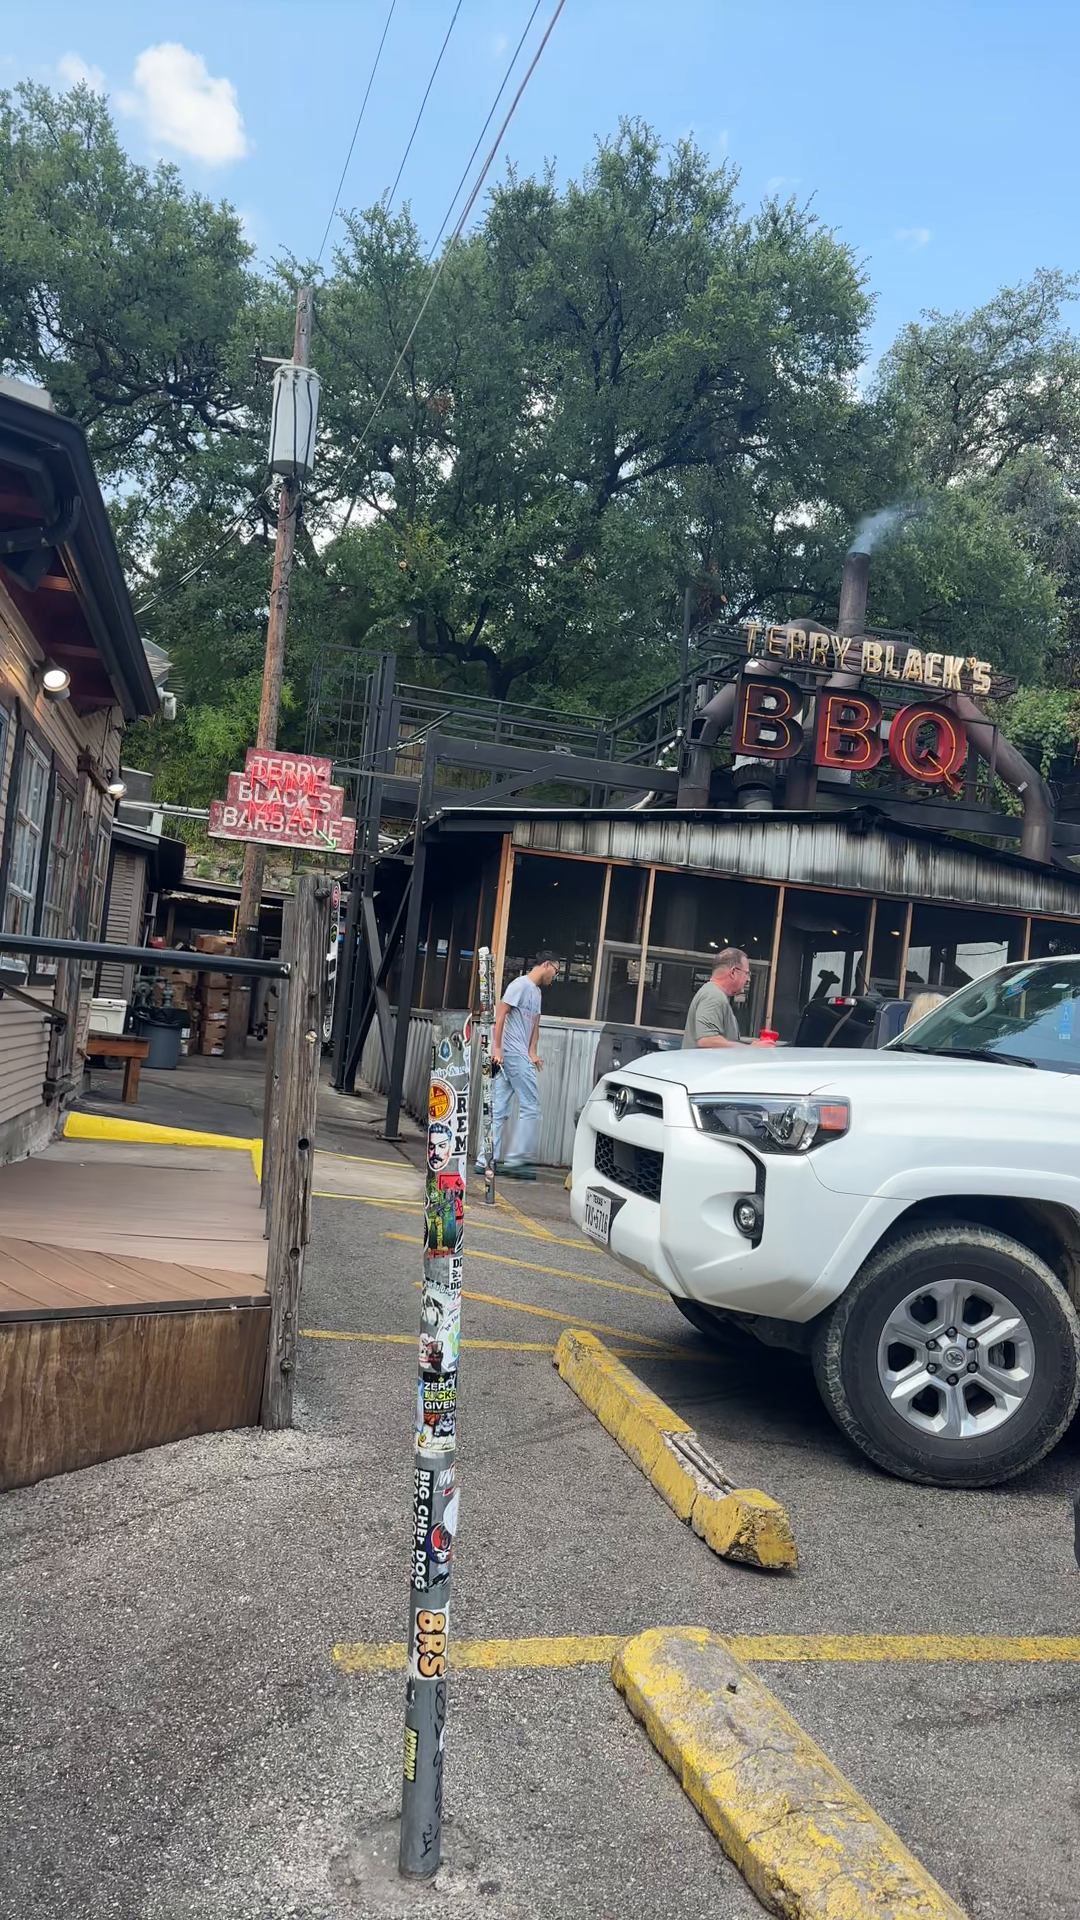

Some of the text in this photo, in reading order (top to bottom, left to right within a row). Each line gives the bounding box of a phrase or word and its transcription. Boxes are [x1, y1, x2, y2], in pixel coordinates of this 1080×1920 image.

[743, 622, 993, 695] TERRY BLACK'S
[731, 672, 968, 794] BBQ
[250, 764, 326, 797] PRIME
[254, 757, 326, 782] TERRY
[221, 806, 344, 842] BARBECUE
[247, 801, 324, 830] MEAT
[424, 1400, 456, 1410] GIVEN
[418, 1469, 431, 1500] BIG
[414, 1549, 428, 1590] DOG
